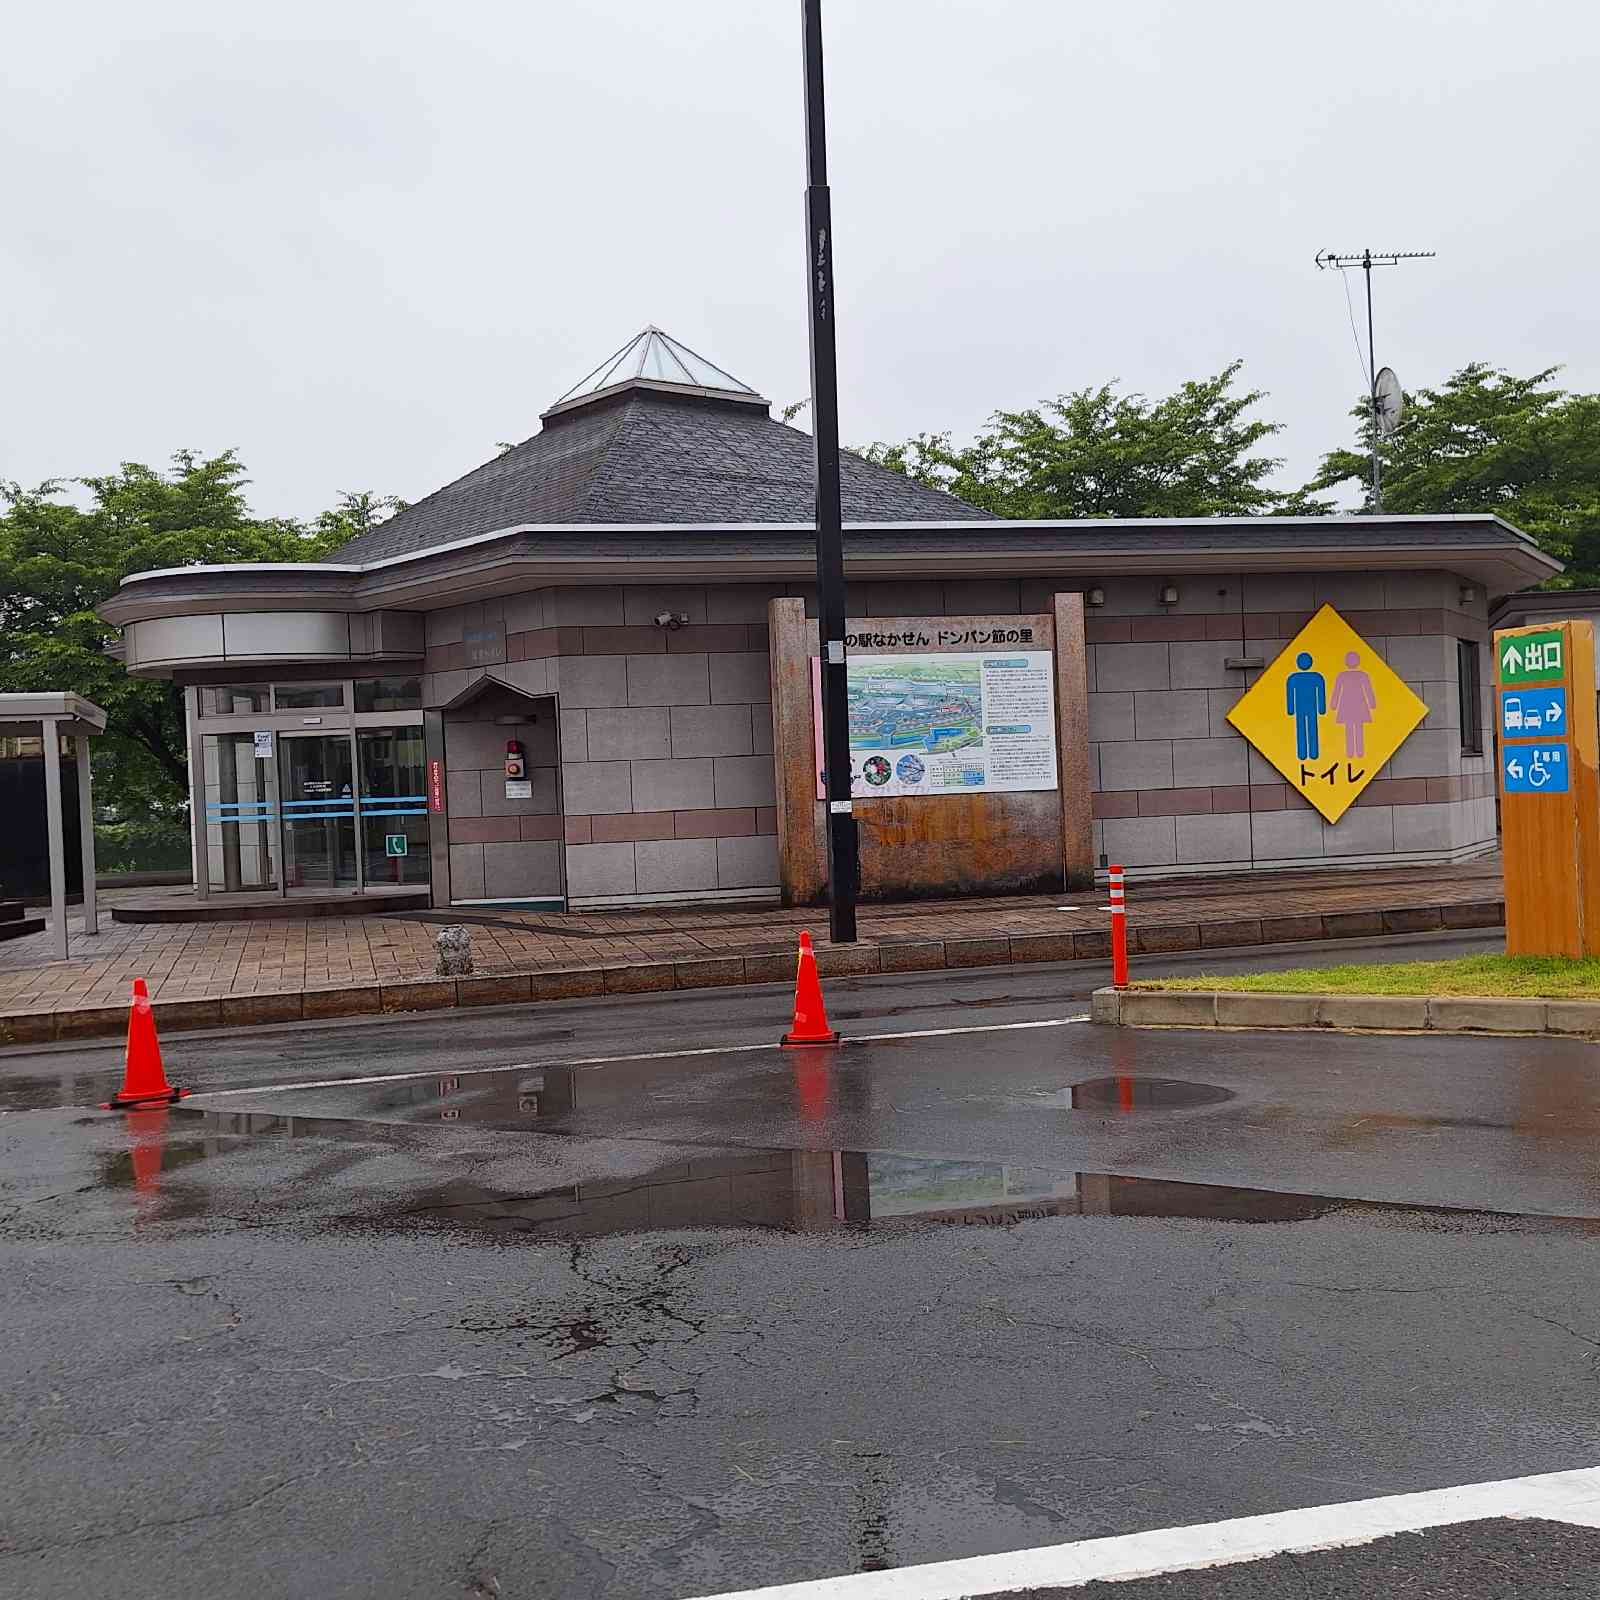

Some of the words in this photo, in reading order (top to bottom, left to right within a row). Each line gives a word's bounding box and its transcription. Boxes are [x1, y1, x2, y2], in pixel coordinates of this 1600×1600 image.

[1525, 642, 1560, 672] 出口
[1301, 762, 1364, 786] トイレ
